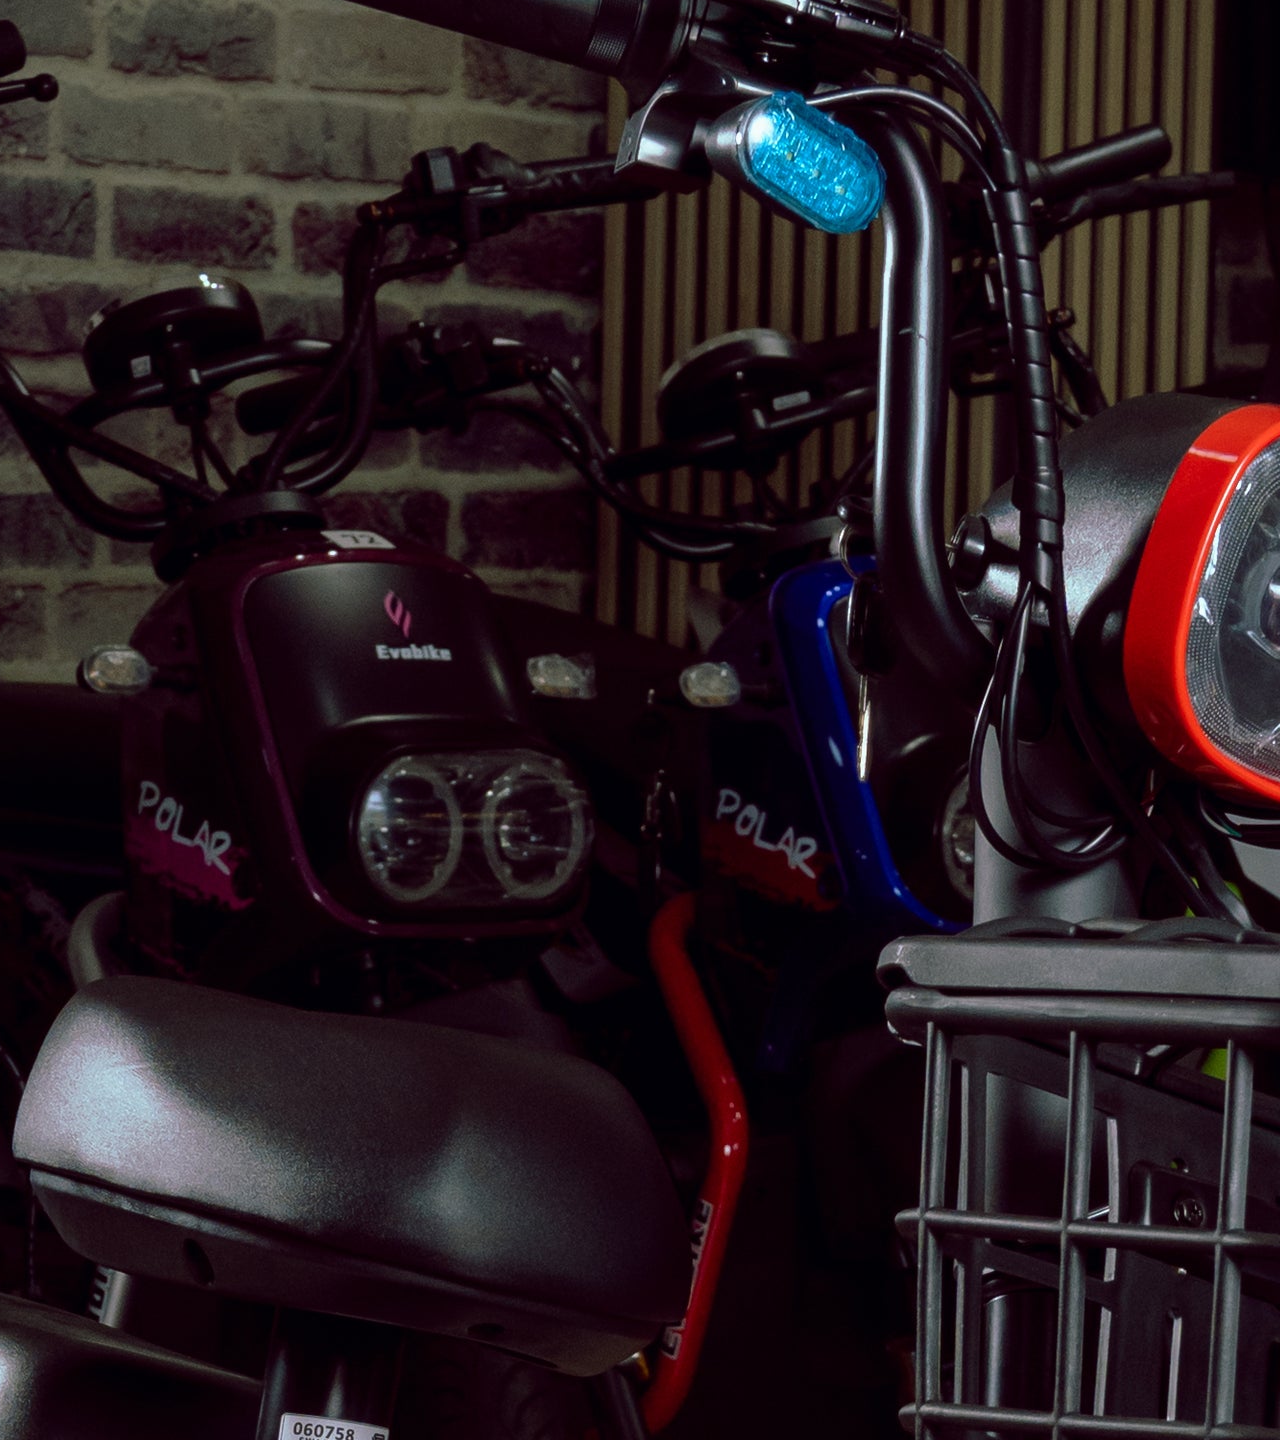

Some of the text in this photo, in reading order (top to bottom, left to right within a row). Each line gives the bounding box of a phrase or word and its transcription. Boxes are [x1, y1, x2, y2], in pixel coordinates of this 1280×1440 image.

[375, 643, 453, 662] Evobike
[138, 780, 232, 876] POLAR
[715, 786, 819, 880] POLAR
